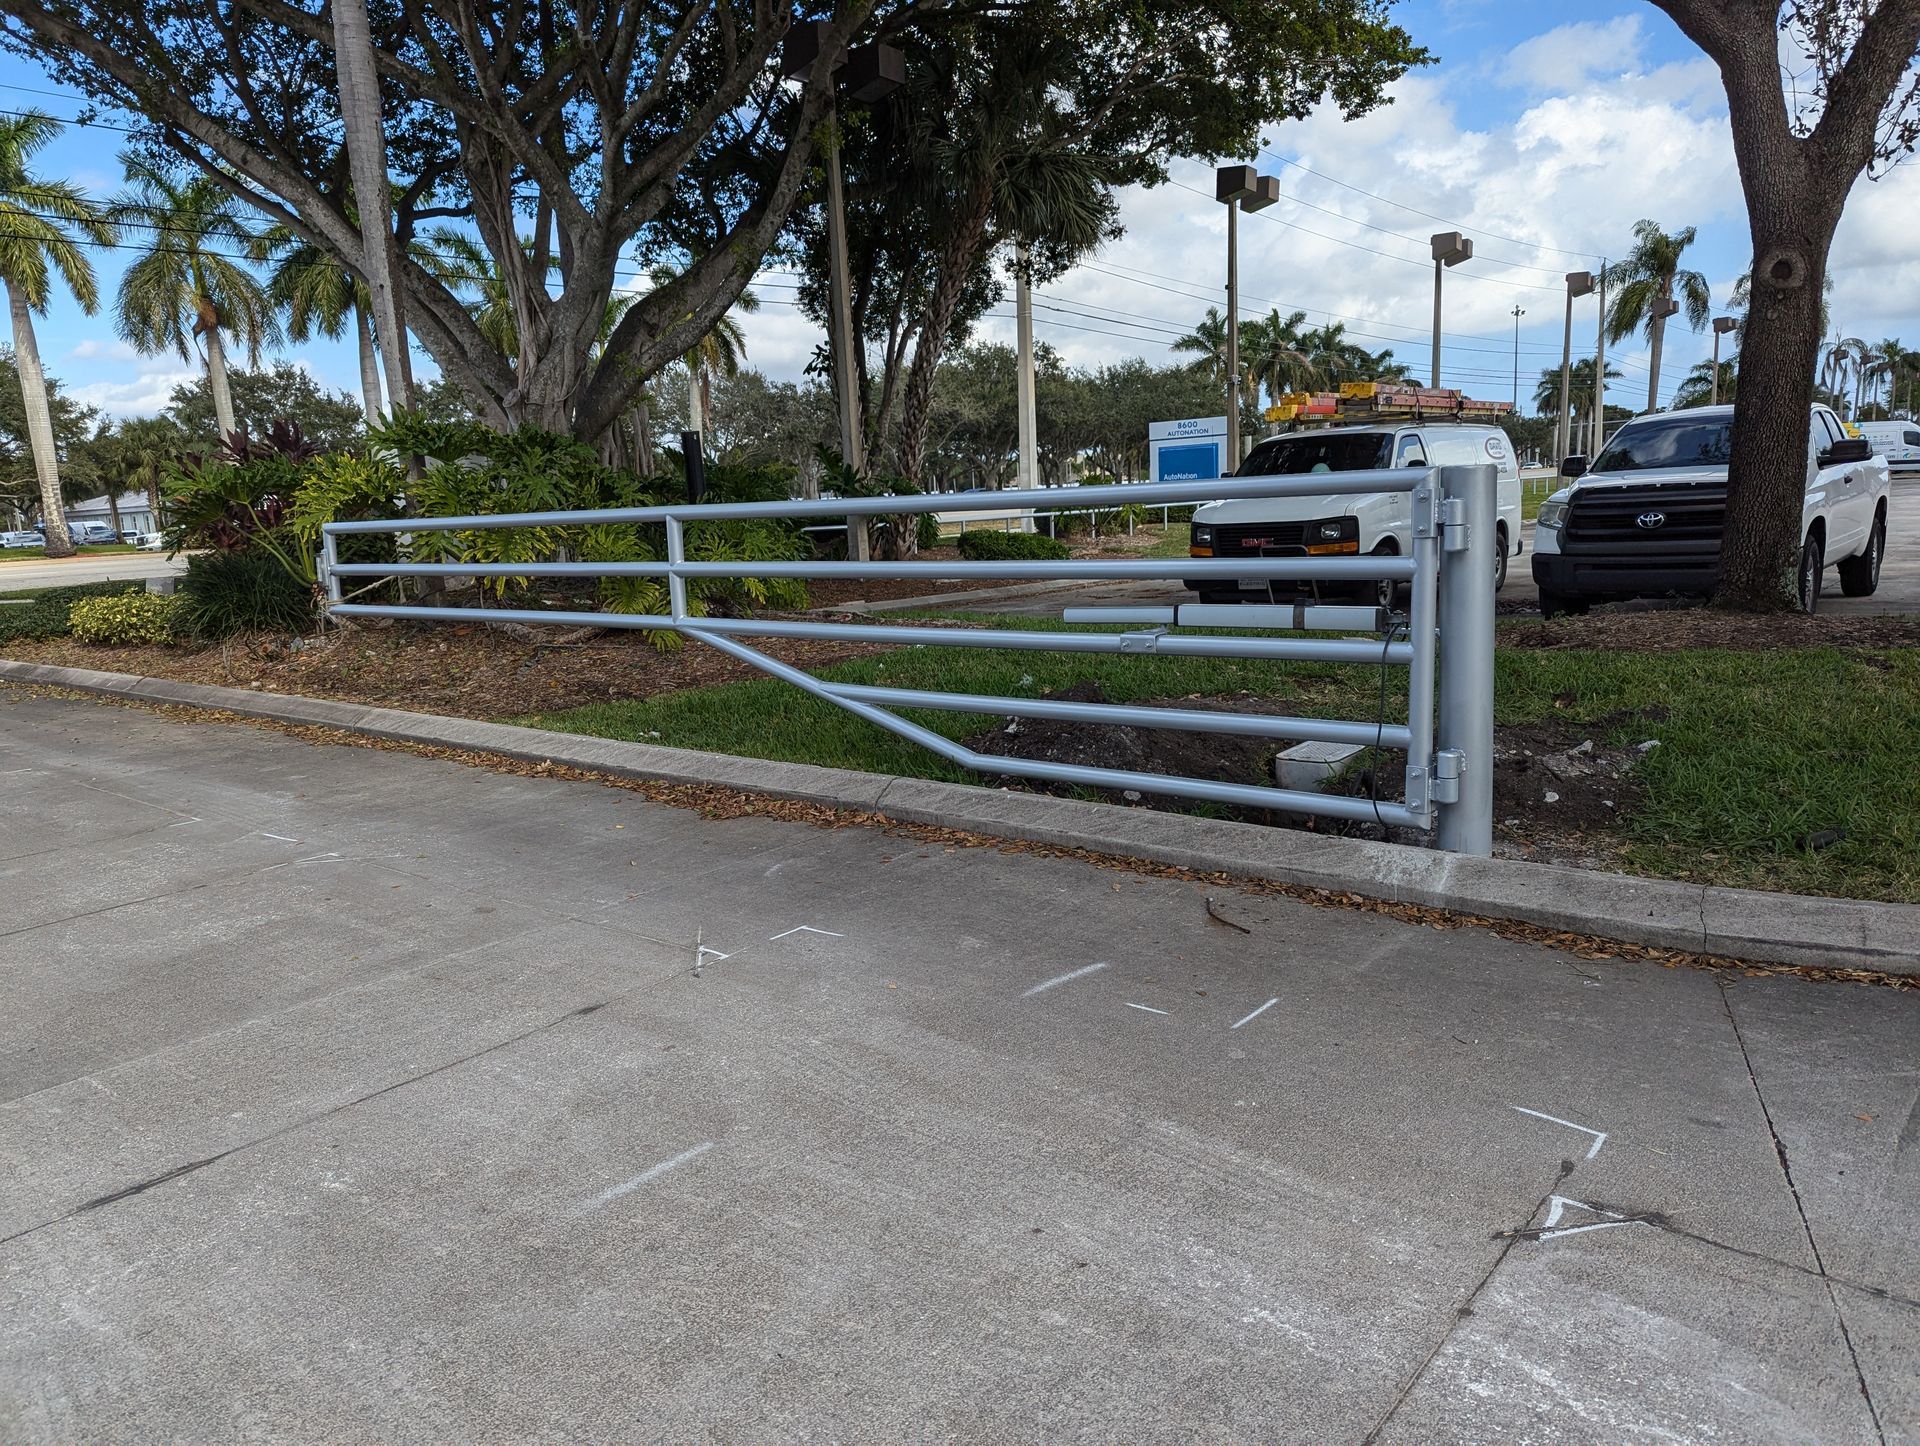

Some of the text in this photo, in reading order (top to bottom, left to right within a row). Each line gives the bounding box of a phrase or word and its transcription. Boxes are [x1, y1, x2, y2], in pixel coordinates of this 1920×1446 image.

[1177, 421, 1198, 429] 8600
[1167, 428, 1209, 437] AUTONATION
[1163, 472, 1198, 481] AutoNation
[1241, 538, 1273, 548] GMC
